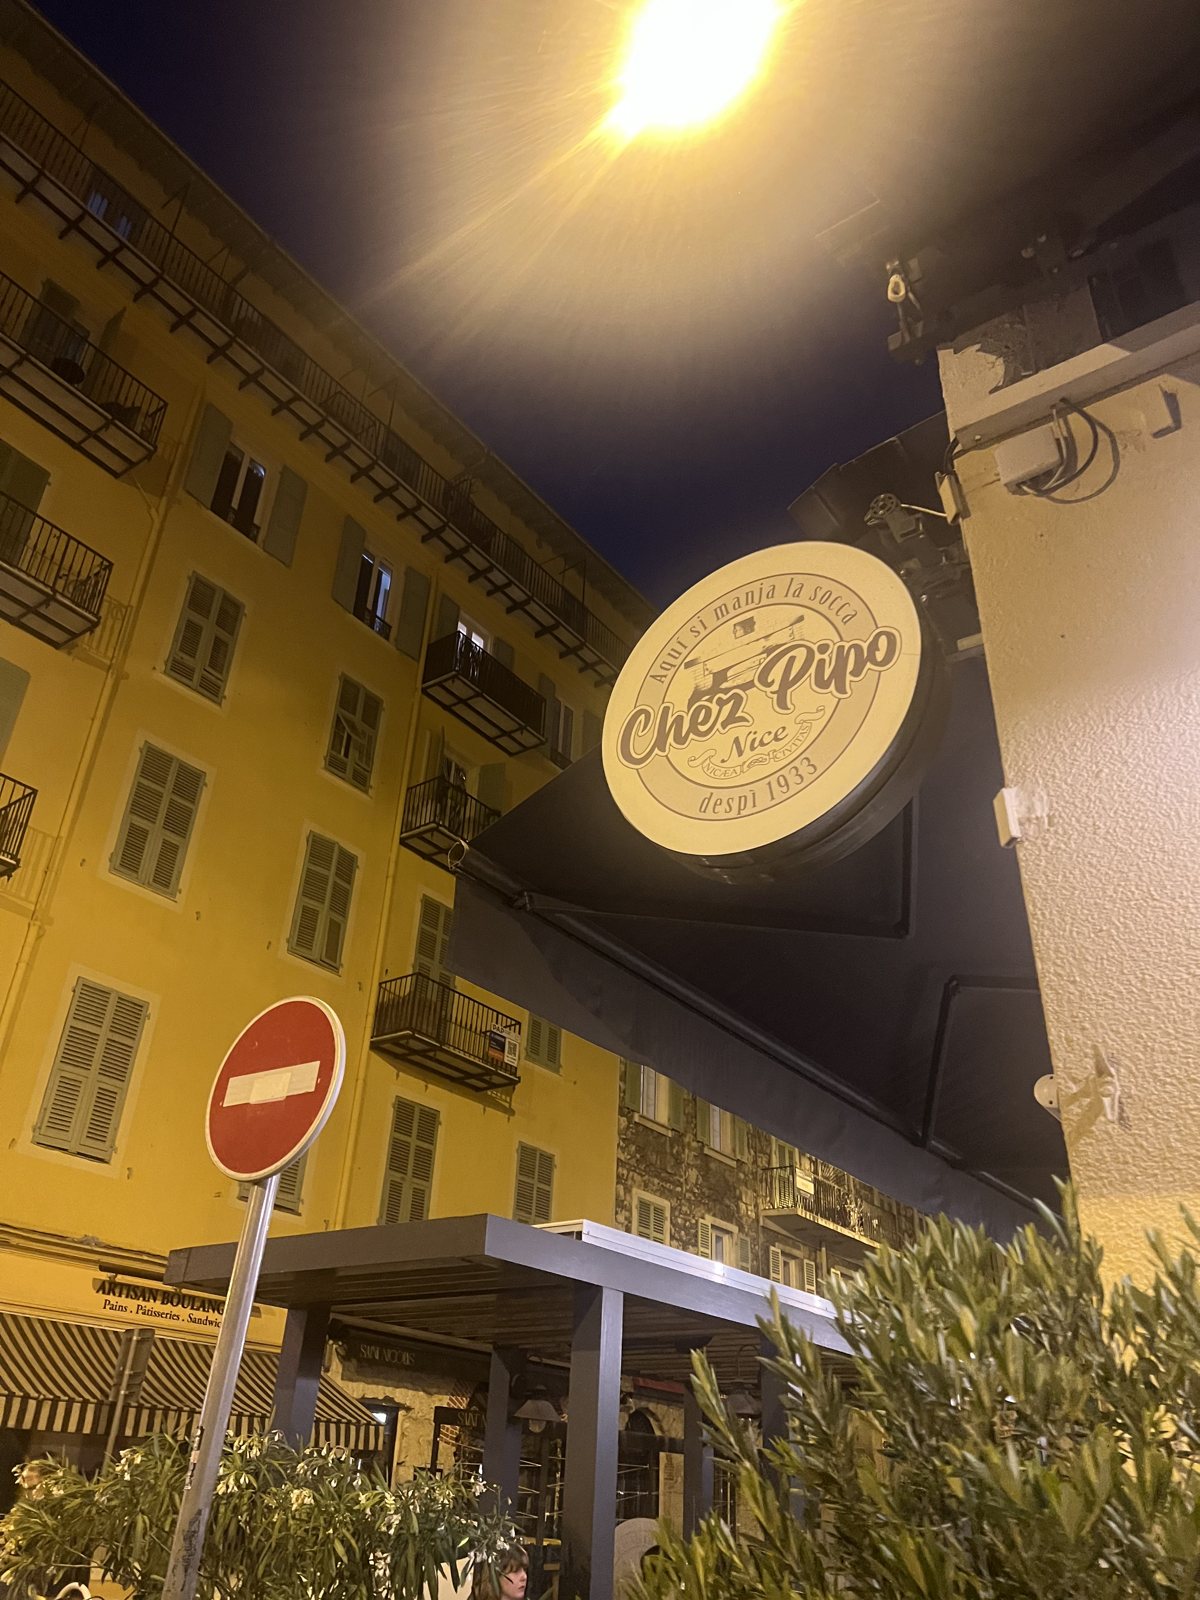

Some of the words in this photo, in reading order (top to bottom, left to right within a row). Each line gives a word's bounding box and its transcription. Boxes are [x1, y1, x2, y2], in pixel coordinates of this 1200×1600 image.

[690, 616, 707, 638] si
[713, 583, 776, 621] manja
[784, 577, 804, 598] la
[808, 585, 857, 625] socca
[618, 691, 752, 767] Chez
[756, 629, 899, 712] Pipo
[720, 726, 788, 763] Nice
[766, 757, 817, 802] 1933
[96, 1280, 158, 1303] ARTISAN
[161, 1290, 226, 1315] BOULANG
[103, 1299, 128, 1312] Pains
[187, 1313, 222, 1328] Sandwic
